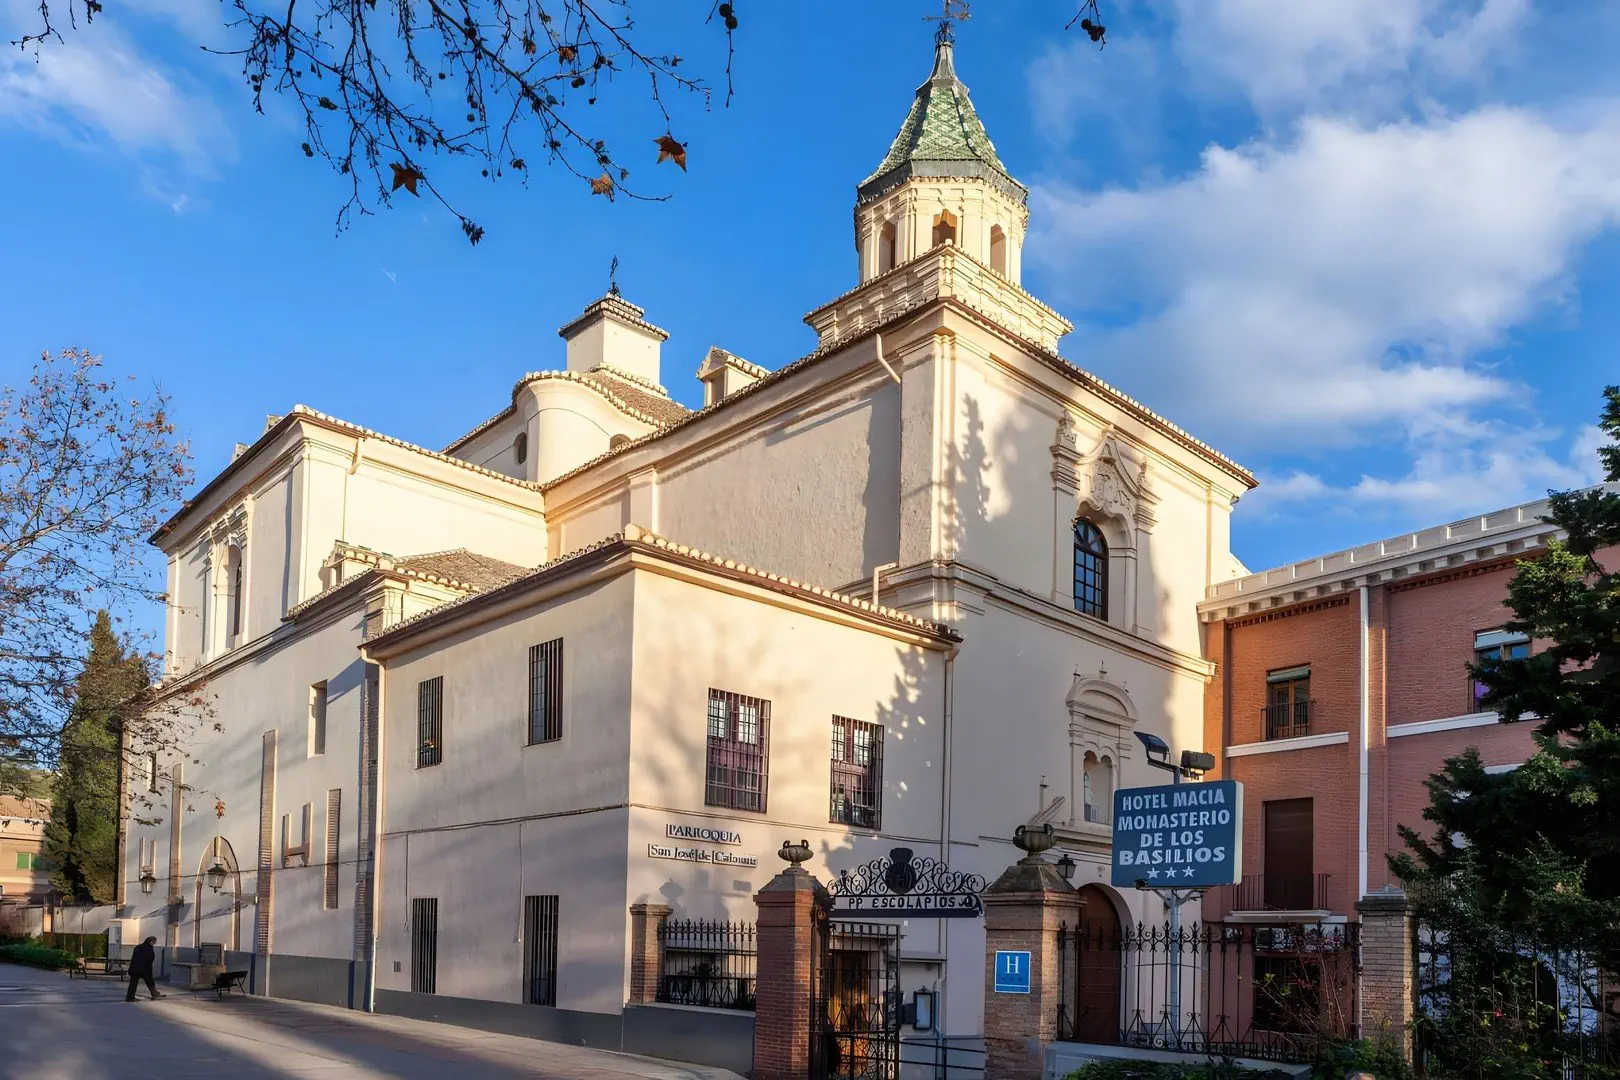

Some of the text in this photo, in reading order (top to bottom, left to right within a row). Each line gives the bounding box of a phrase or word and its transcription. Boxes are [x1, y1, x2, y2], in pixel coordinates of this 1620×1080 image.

[1122, 788, 1225, 811] HOTEL MACIA
[1118, 809, 1230, 831] MONASTERIO
[668, 824, 742, 843] PARROQUIA
[1140, 830, 1204, 848] DE LOS
[651, 844, 671, 857] San
[698, 849, 711, 860] de
[1119, 846, 1226, 866] BASILIOS
[871, 896, 956, 909] ESCOLAPIOS
[1005, 955, 1020, 974] H
